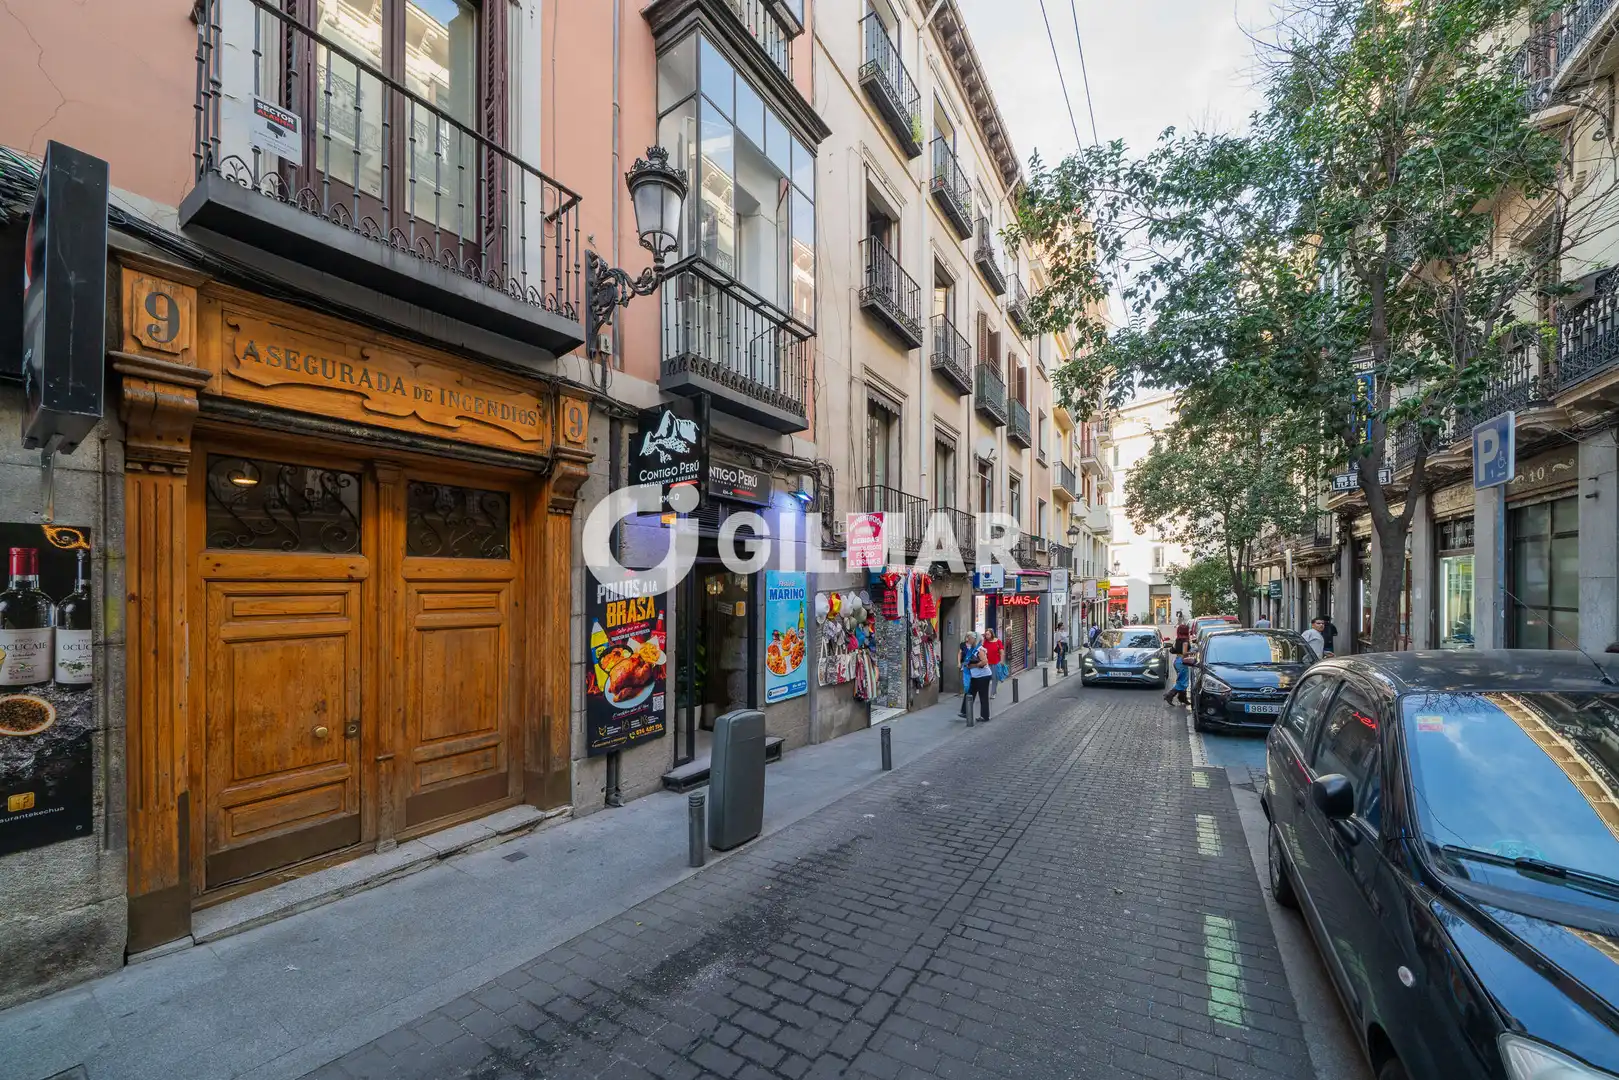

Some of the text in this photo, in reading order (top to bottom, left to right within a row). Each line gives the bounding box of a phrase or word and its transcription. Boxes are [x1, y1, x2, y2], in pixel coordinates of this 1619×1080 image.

[257, 102, 294, 124] SECTOR
[145, 292, 180, 343] 9
[242, 340, 407, 397] ASEGURADA
[413, 386, 434, 403] DE
[568, 406, 583, 438] 9
[1478, 428, 1500, 482] P
[639, 460, 700, 481] CONTIGO PERÚ
[675, 473, 698, 482] PERUANA
[709, 465, 758, 487] NTIGO PERÚ
[1530, 467, 1545, 482] 10
[769, 588, 805, 601] MARINO
[606, 594, 656, 628] BRASA
[62, 642, 92, 651] OCUC
[1251, 705, 1274, 713] 9863
